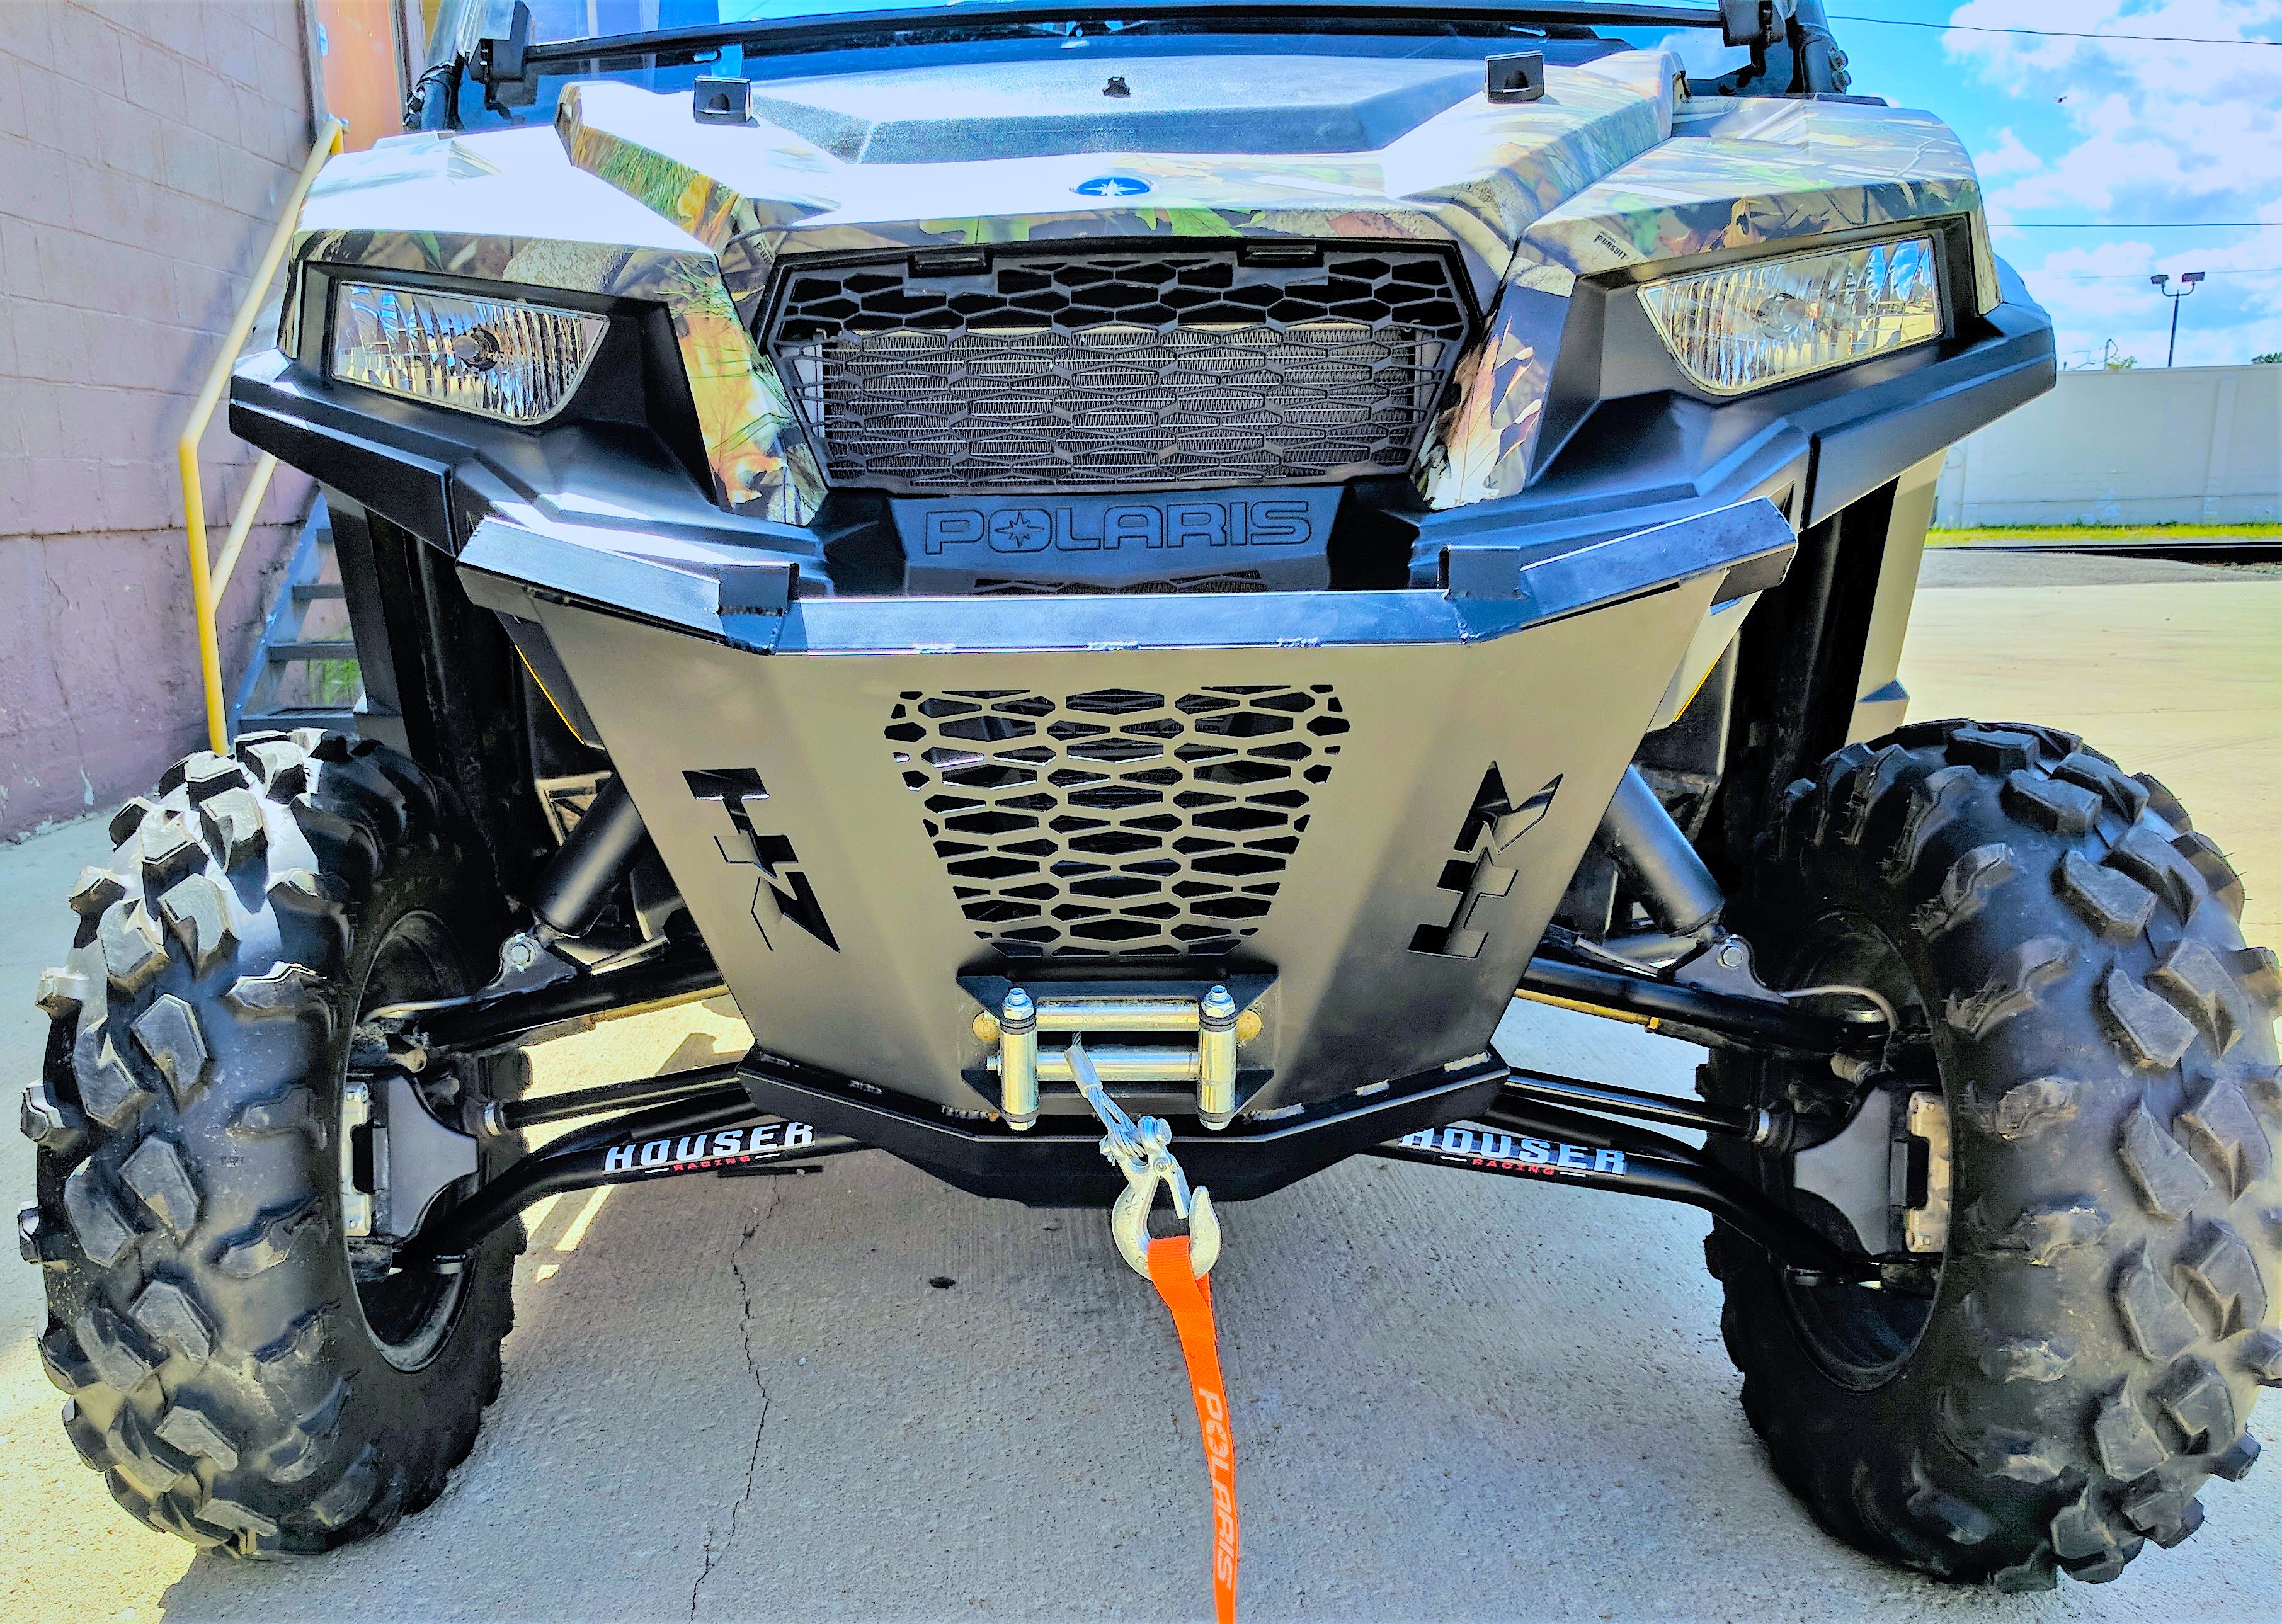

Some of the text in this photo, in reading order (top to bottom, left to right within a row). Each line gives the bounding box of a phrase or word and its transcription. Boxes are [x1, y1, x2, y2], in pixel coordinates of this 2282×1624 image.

[1594, 234, 1628, 259] PURSUIT
[925, 501, 1311, 555] POLARIS
[605, 1121, 814, 1172] HOUSER
[673, 1156, 751, 1171] RACING
[1401, 1128, 1626, 1174] HOUSER
[1472, 1159, 1555, 1175] RACING
[1198, 1387, 1234, 1588] POLARIS
